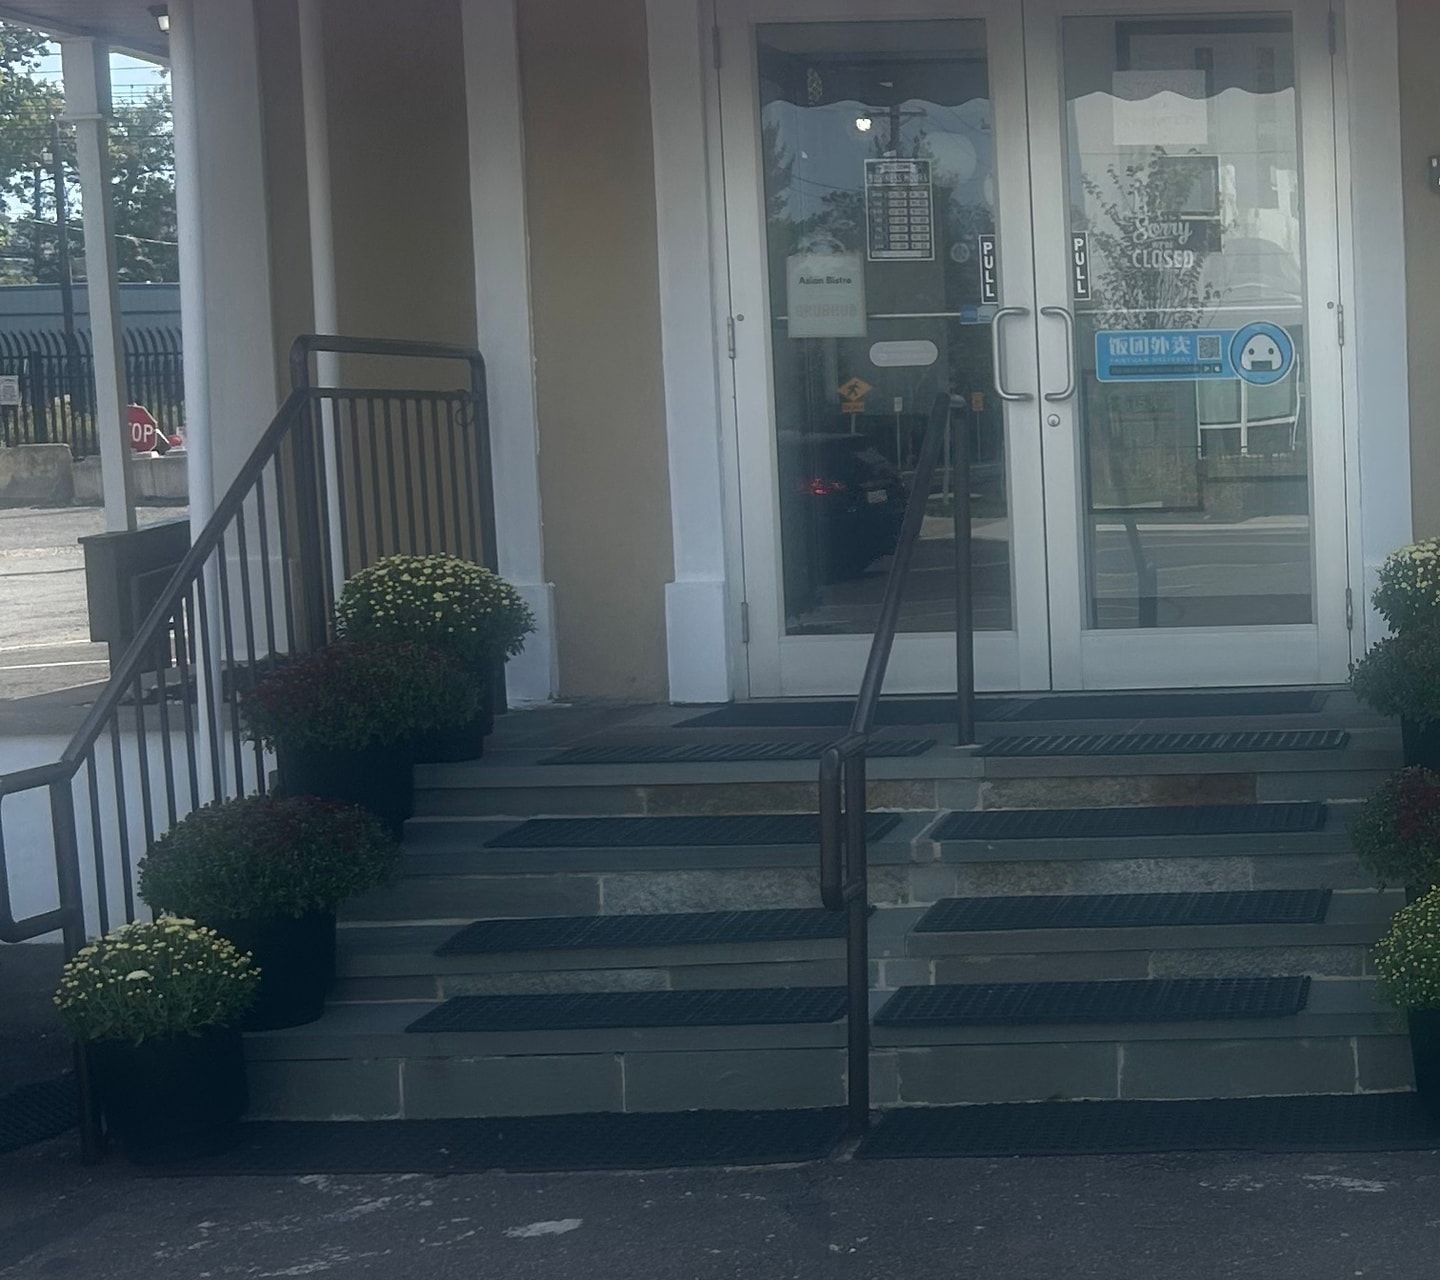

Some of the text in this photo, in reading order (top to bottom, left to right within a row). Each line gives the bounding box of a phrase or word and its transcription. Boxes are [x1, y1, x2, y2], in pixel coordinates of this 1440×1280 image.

[1133, 217, 1192, 245] Sorry
[983, 242, 994, 297] PULL
[1074, 238, 1086, 293] PULL
[1133, 250, 1193, 268] CLOSED
[799, 276, 852, 284] Asian Bistro
[1109, 336, 1191, 355] 饭团外卖
[129, 422, 154, 443] OP
